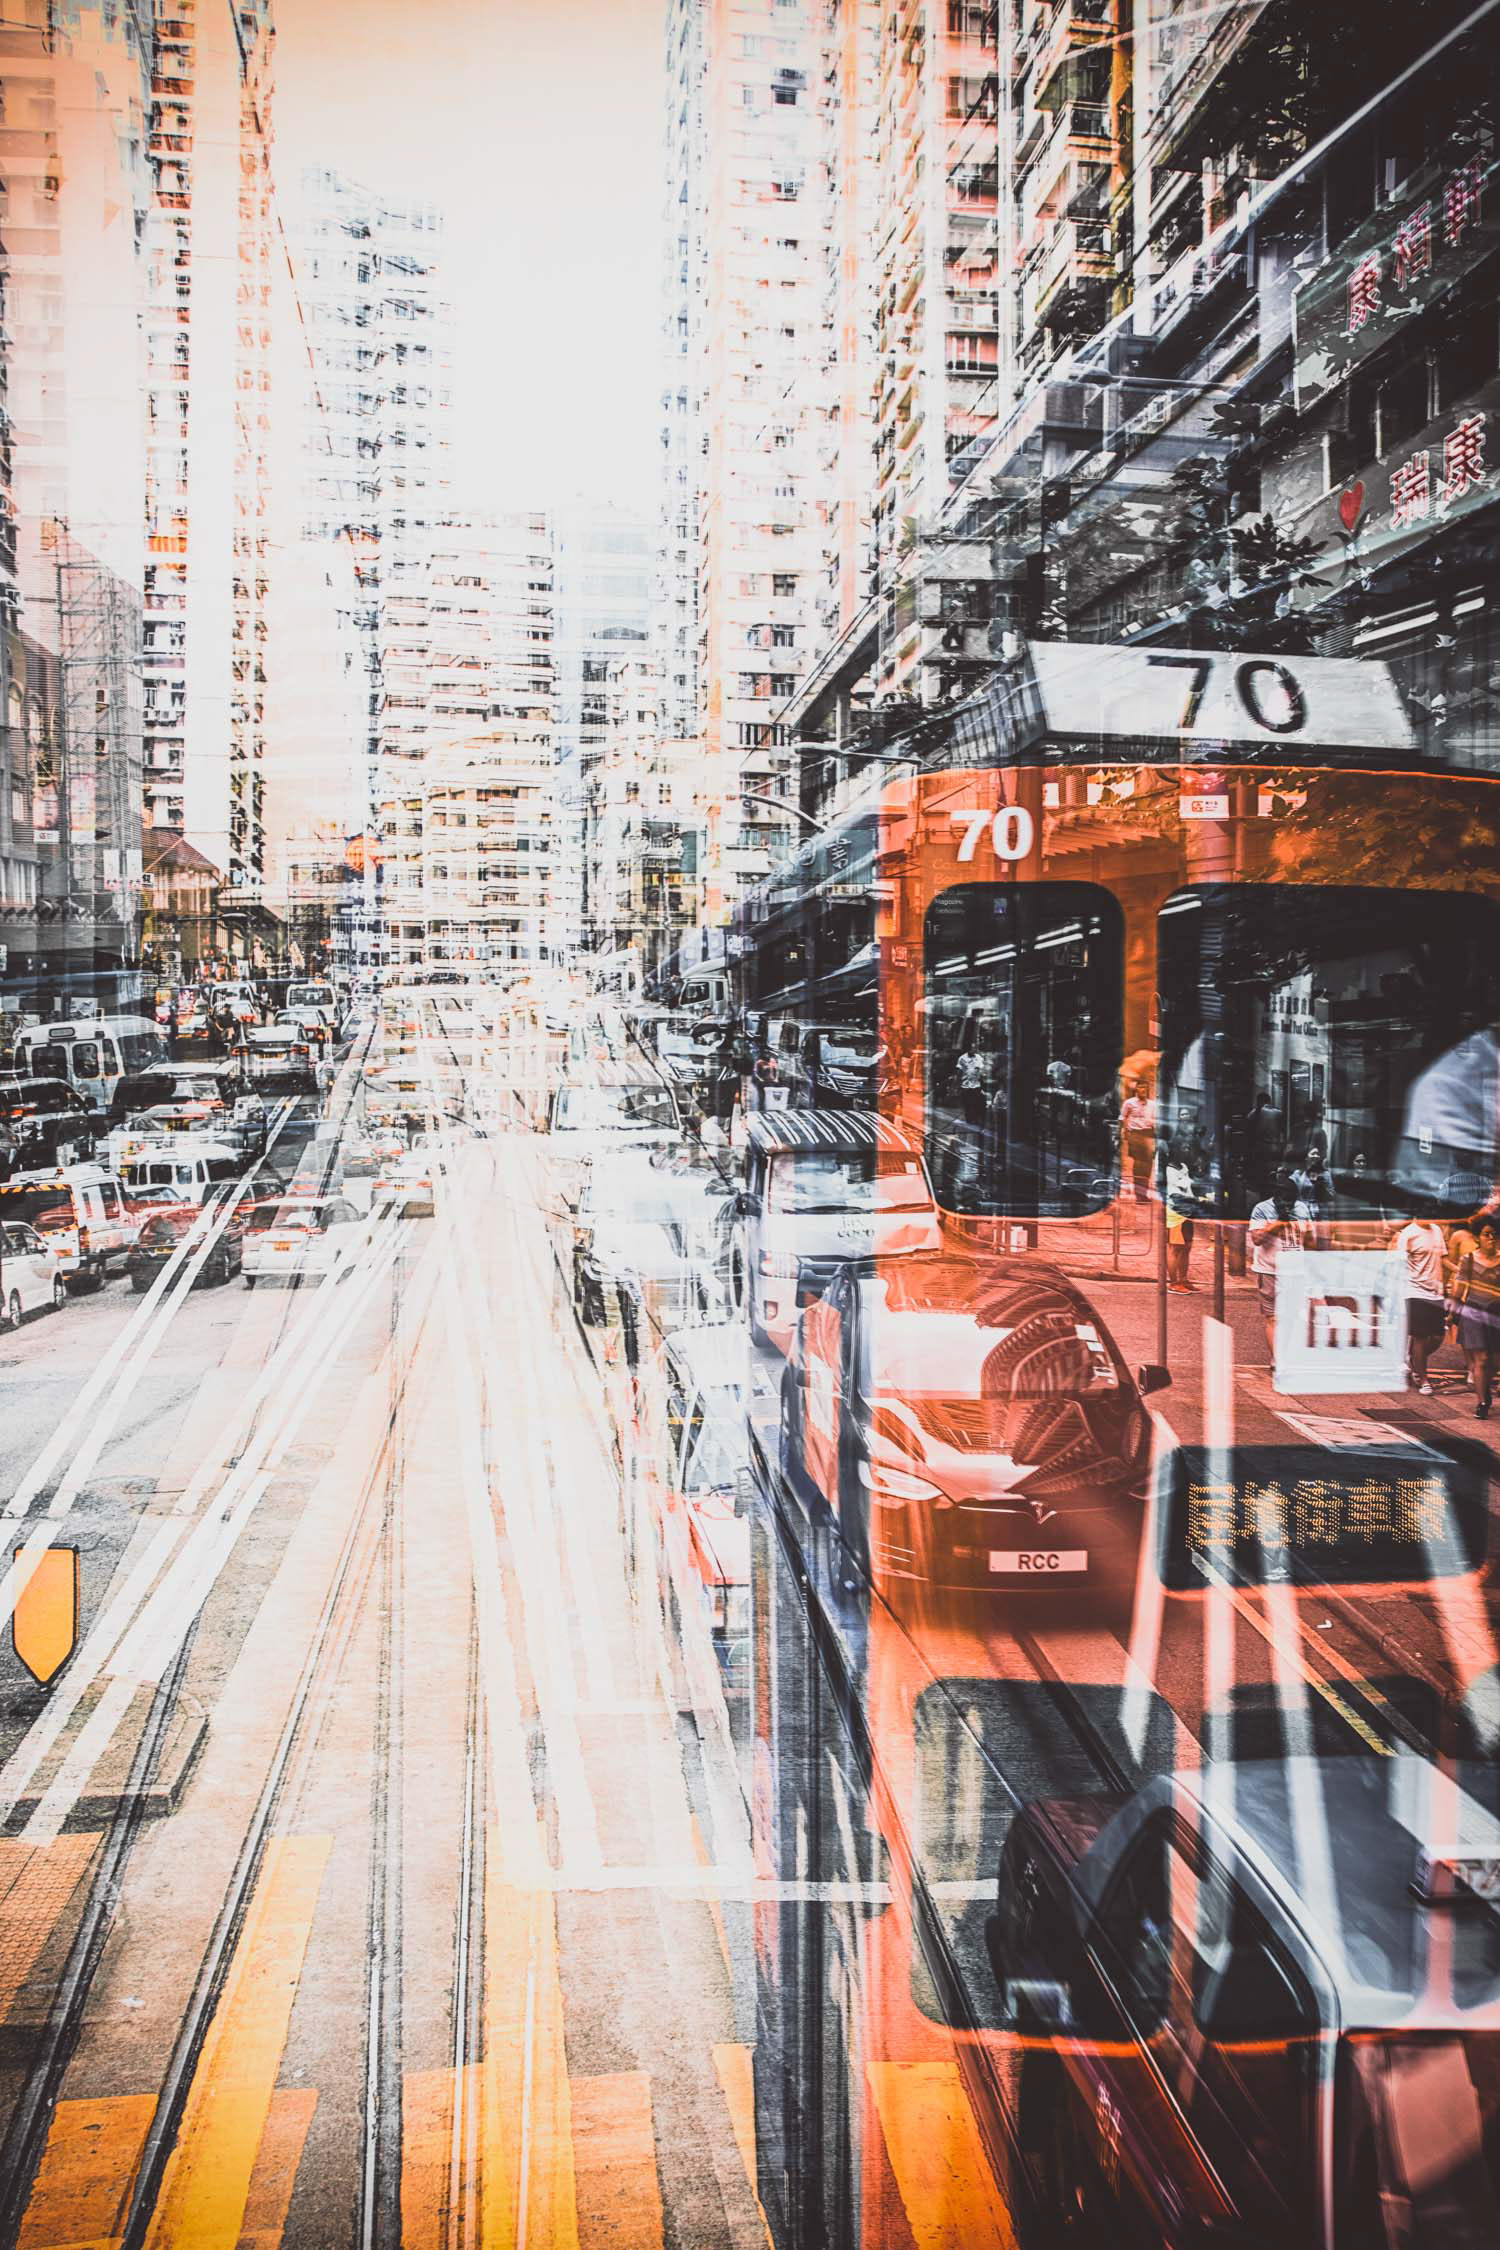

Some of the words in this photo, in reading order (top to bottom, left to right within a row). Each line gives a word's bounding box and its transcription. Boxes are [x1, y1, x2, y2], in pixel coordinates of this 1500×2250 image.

[1147, 655, 1309, 734] 70
[950, 805, 1035, 862] 70
[1017, 1553, 1060, 1570] RCC
